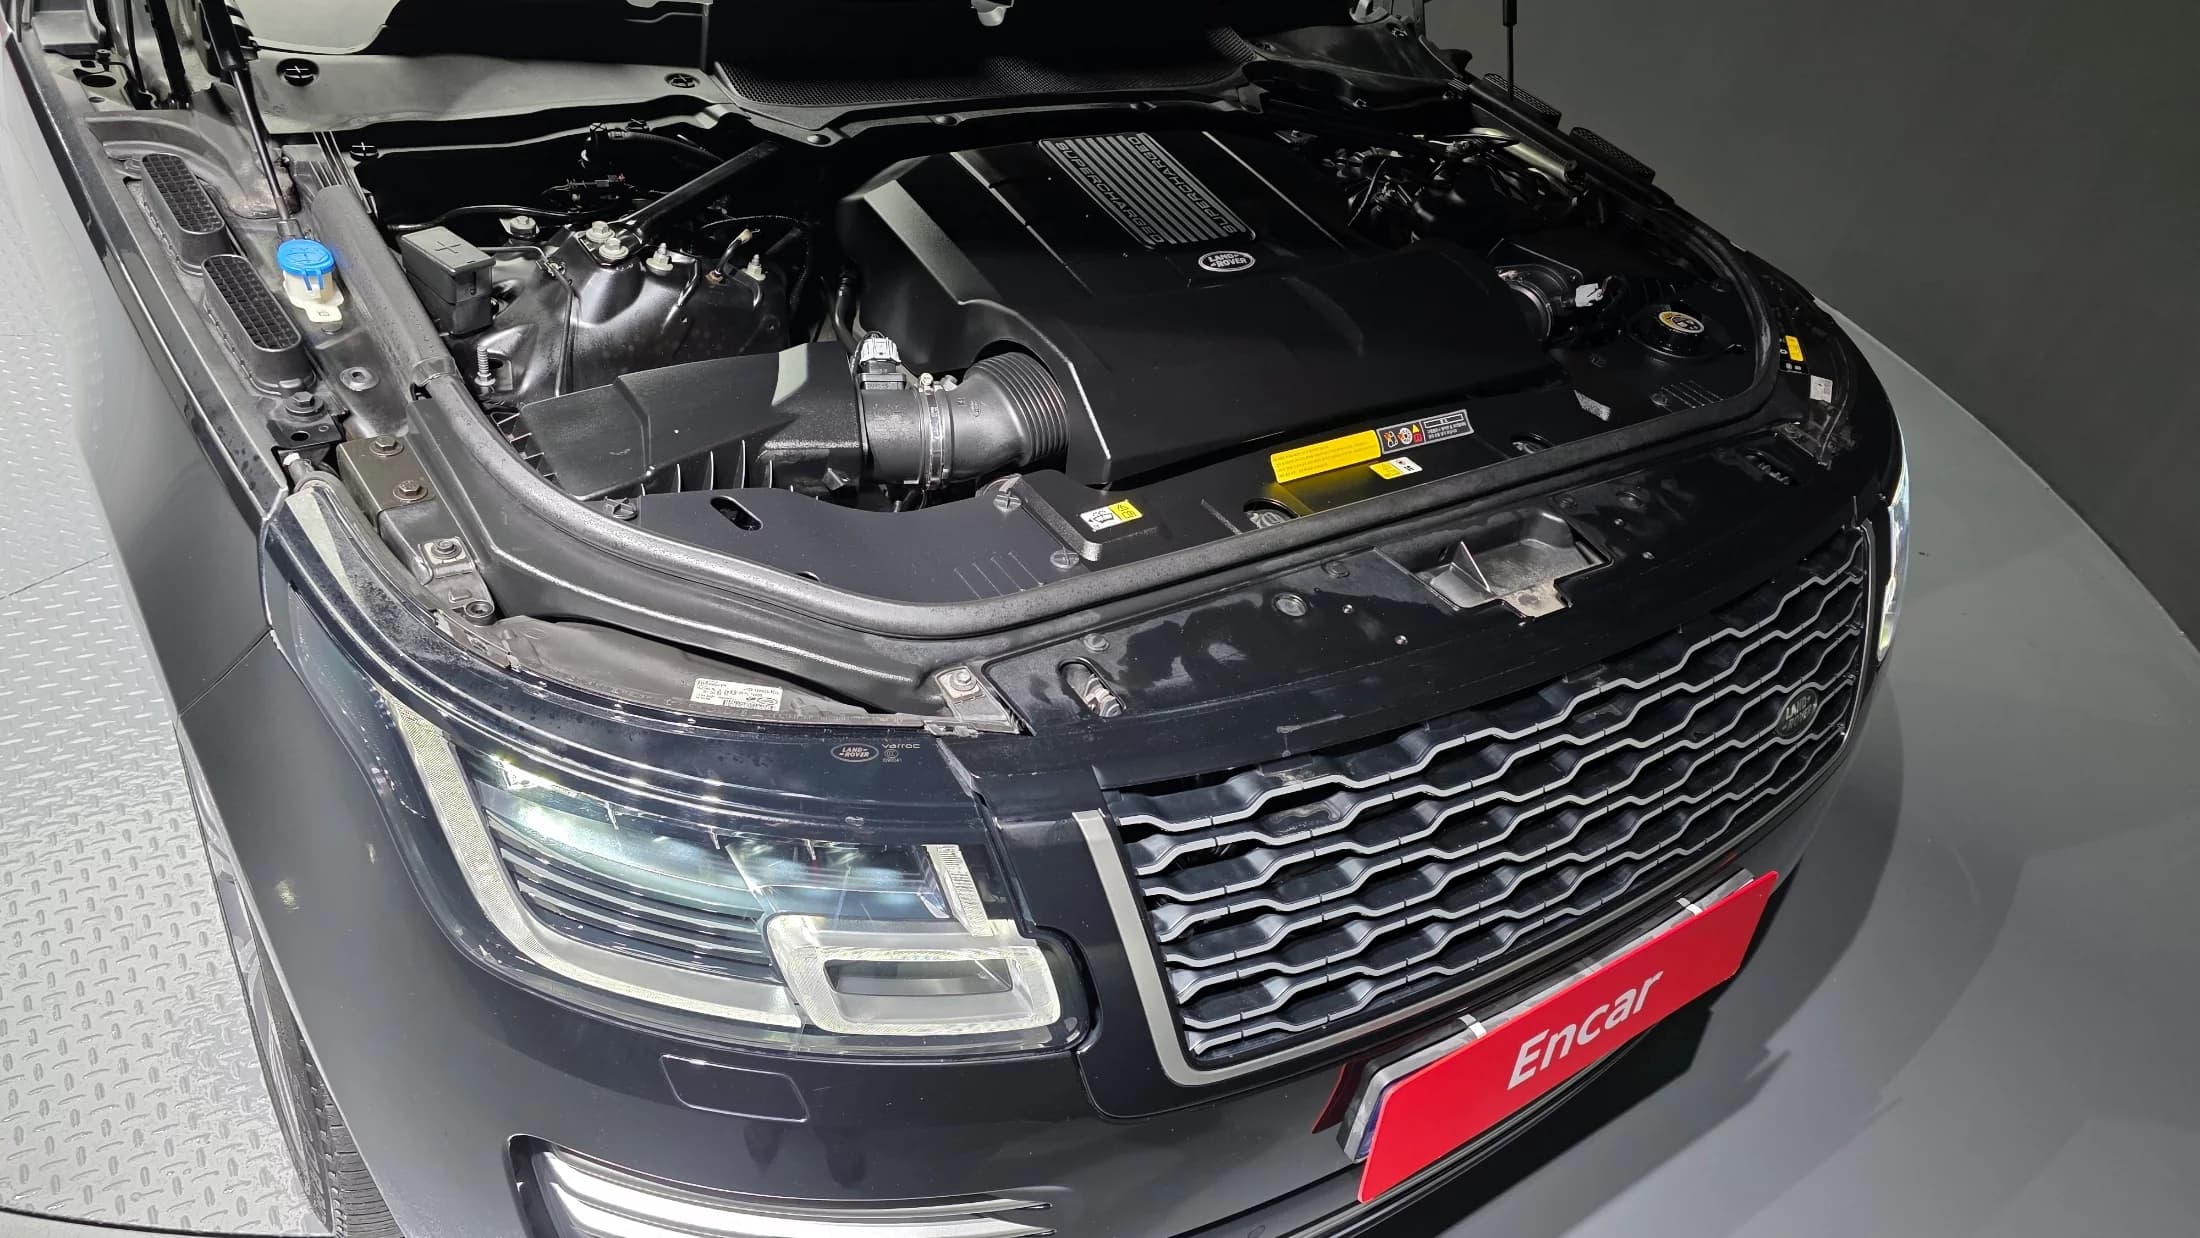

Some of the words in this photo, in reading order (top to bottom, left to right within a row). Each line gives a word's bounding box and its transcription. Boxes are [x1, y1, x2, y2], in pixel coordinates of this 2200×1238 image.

[1055, 142, 1165, 244] SUPERCHARGED
[1127, 136, 1238, 234] SUPERCHARGED
[1208, 254, 1235, 262] LAND
[1216, 257, 1247, 267] ROVER
[1507, 970, 1664, 1090] Encar
